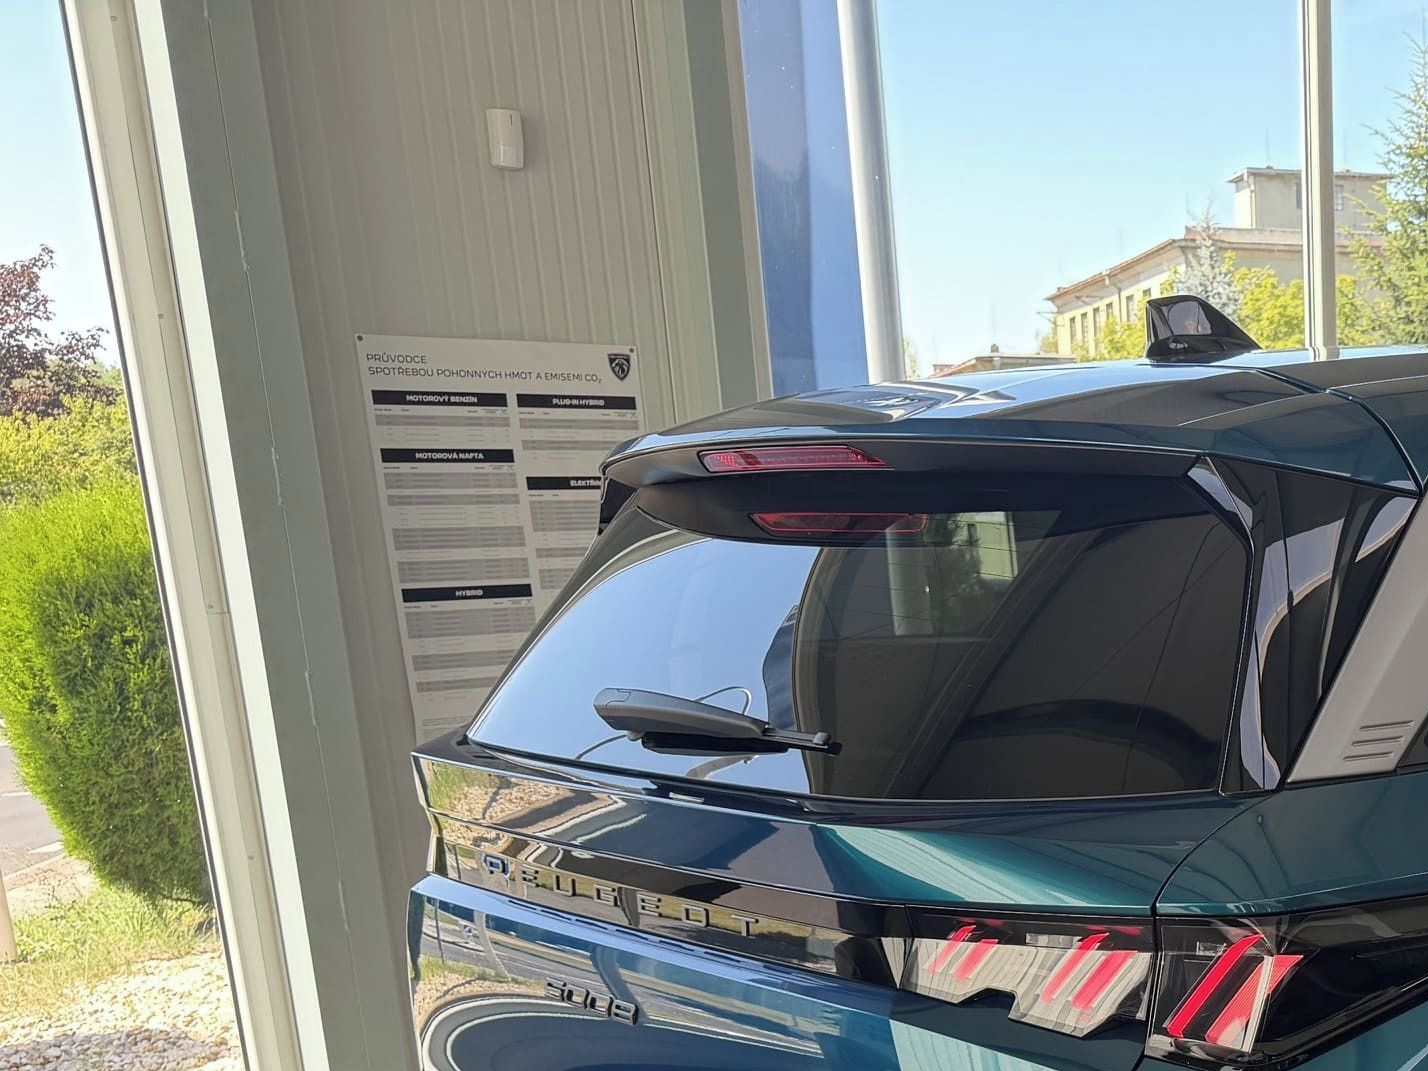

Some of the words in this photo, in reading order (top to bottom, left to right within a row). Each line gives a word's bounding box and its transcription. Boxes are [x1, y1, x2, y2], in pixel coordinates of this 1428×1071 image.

[366, 352, 428, 364] PRŮVODCE
[368, 366, 434, 377] SPOTŘEBOU
[505, 371, 533, 380] HMOT
[536, 372, 543, 380] A
[545, 372, 583, 382] EMISEMI
[481, 853, 759, 937] PEUGEOT
[545, 976, 639, 1026] 5008
